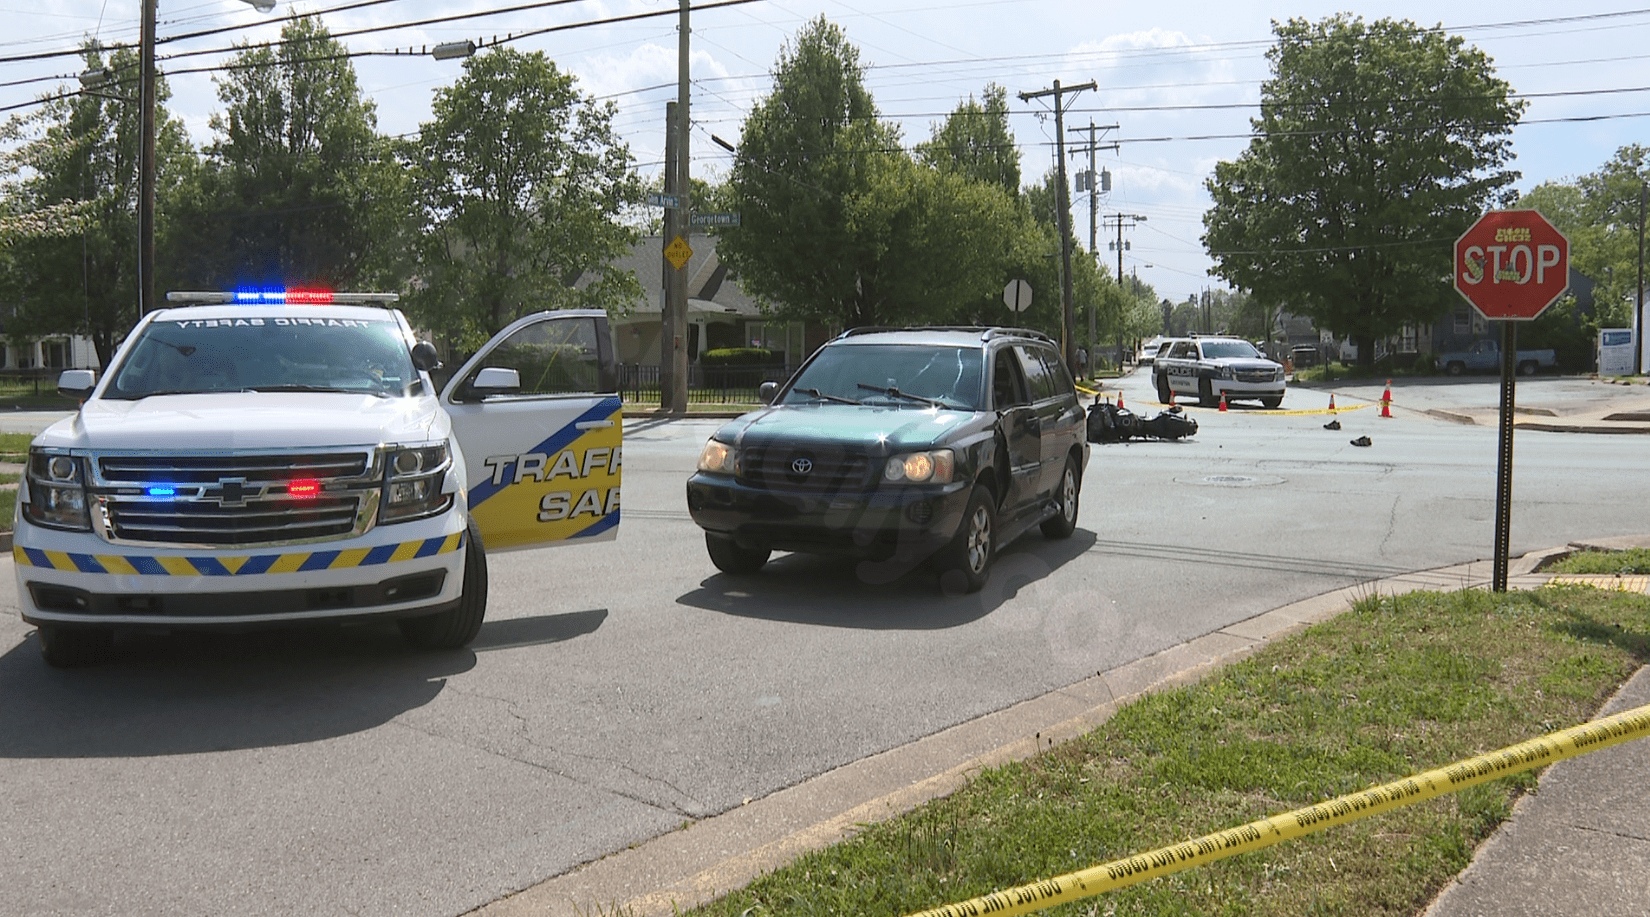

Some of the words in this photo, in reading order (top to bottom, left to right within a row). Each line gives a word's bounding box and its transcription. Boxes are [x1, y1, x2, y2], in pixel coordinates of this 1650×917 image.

[691, 214, 730, 226] Georgetown
[1462, 244, 1560, 285] STOP
[1167, 365, 1192, 376] POLICE
